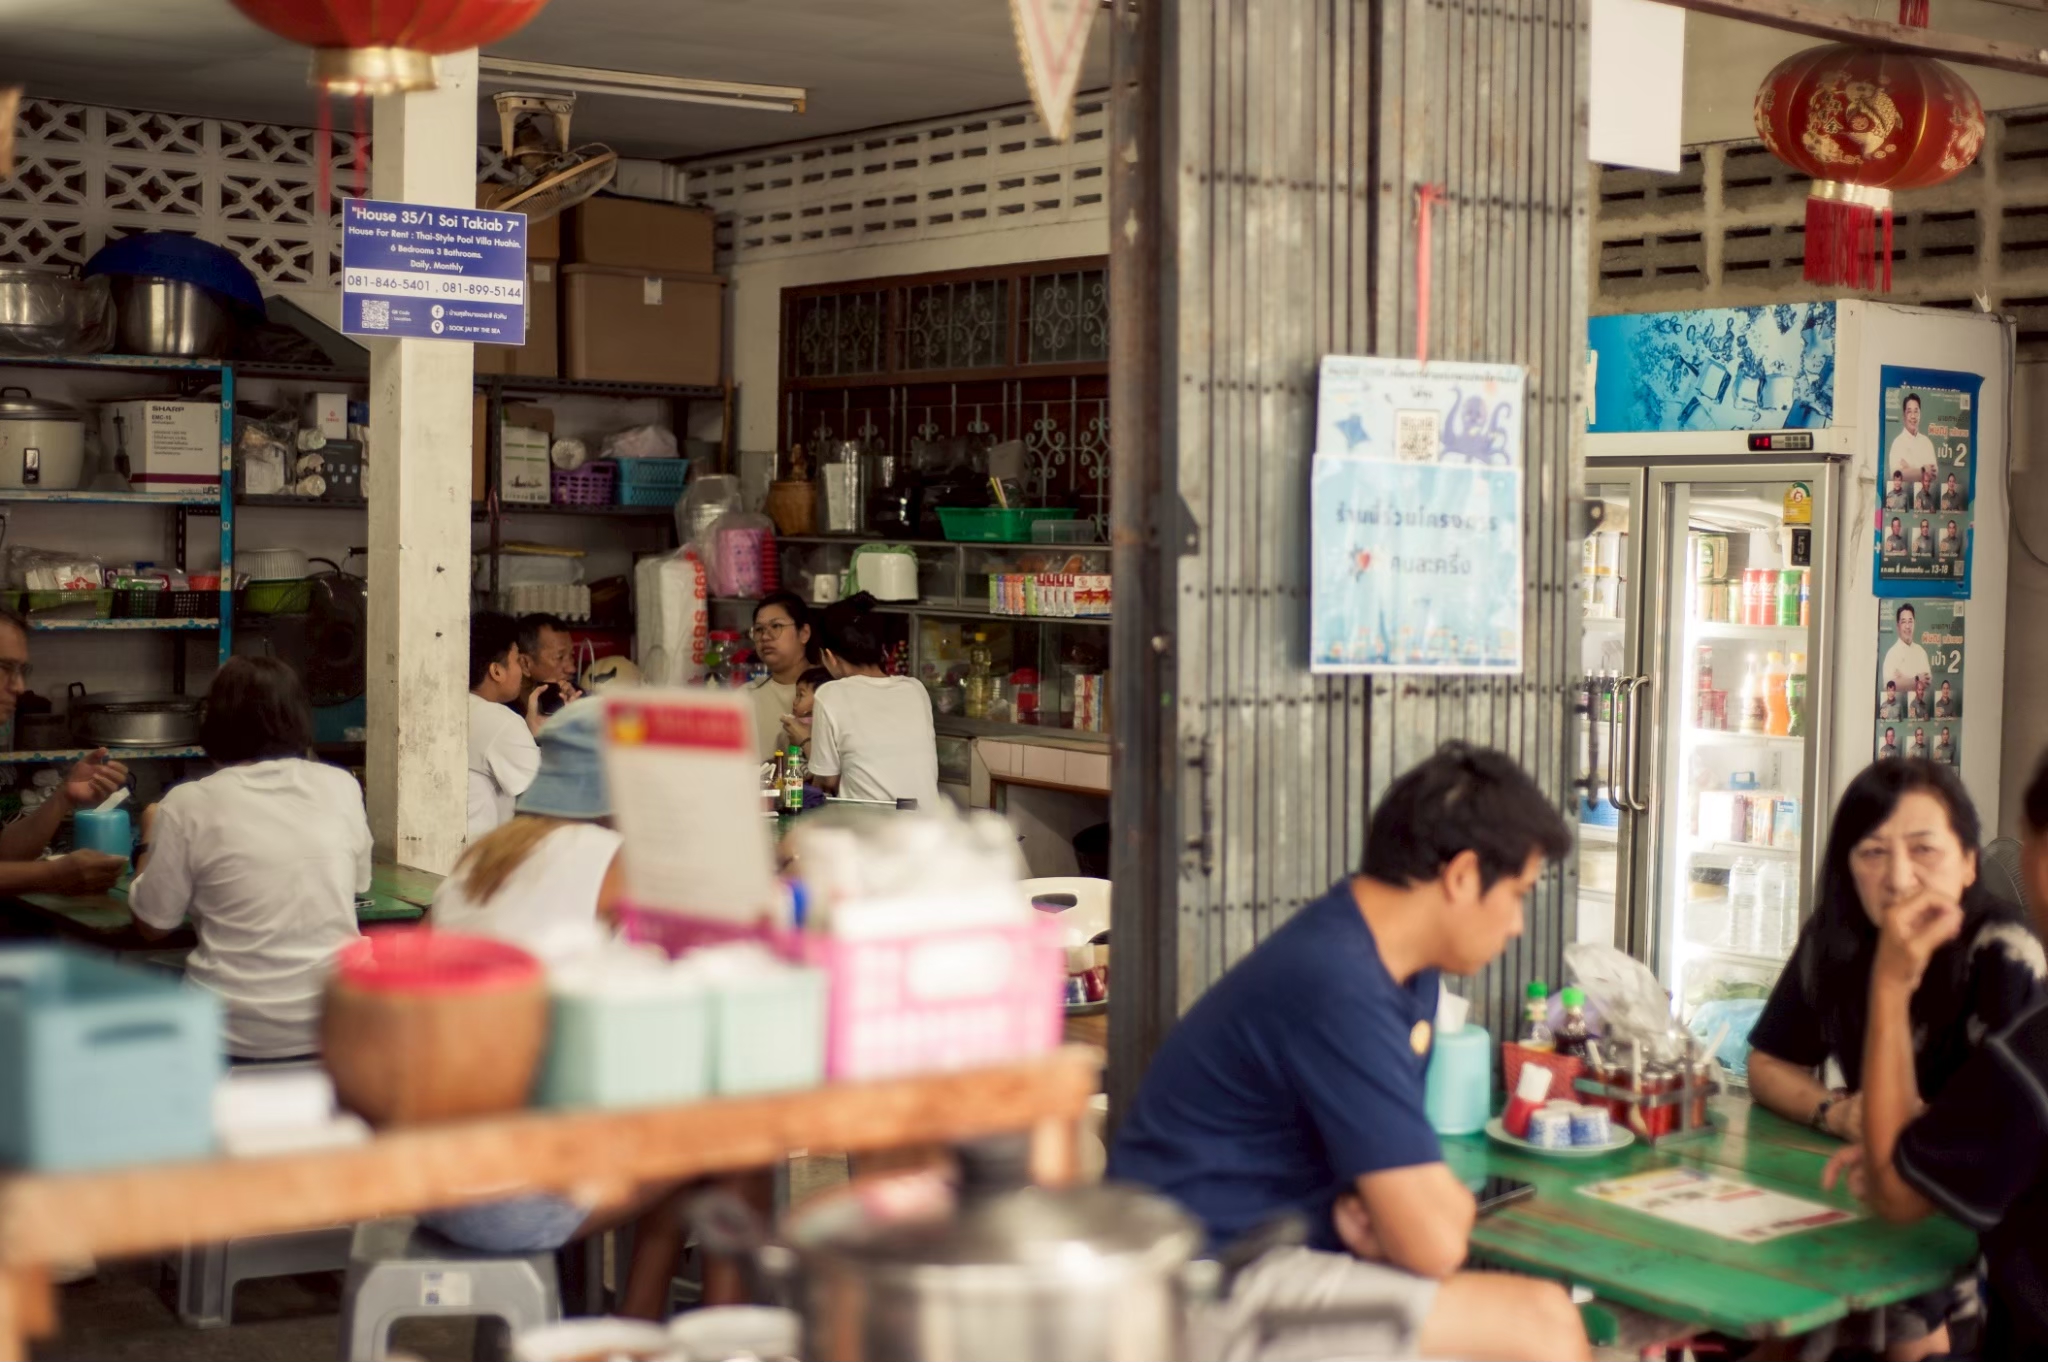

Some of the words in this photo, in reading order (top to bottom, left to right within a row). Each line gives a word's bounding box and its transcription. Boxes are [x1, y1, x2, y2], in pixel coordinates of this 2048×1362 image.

[351, 206, 397, 223] "House
[402, 210, 433, 226] 35/1
[439, 214, 458, 228] Soi
[462, 217, 503, 232] Takiab
[506, 220, 519, 233] 7"
[348, 227, 374, 237] House
[376, 228, 389, 237] For
[391, 229, 409, 239] Rent
[416, 231, 455, 244] Thai-Style
[457, 235, 474, 244] Pool
[476, 236, 493, 246] Villa
[390, 244, 396, 252] 6
[398, 245, 435, 255] Bedrooms
[436, 248, 442, 256] 3
[444, 248, 483, 259] Bathrooms.
[434, 261, 464, 273] Monthly
[347, 275, 430, 292] 081-846-5401
[442, 281, 521, 298] 081-899-5144
[1953, 442, 1968, 467] 2
[1797, 535, 1806, 555] 5
[692, 610, 709, 666] SB99
[1947, 649, 1962, 674] 2
